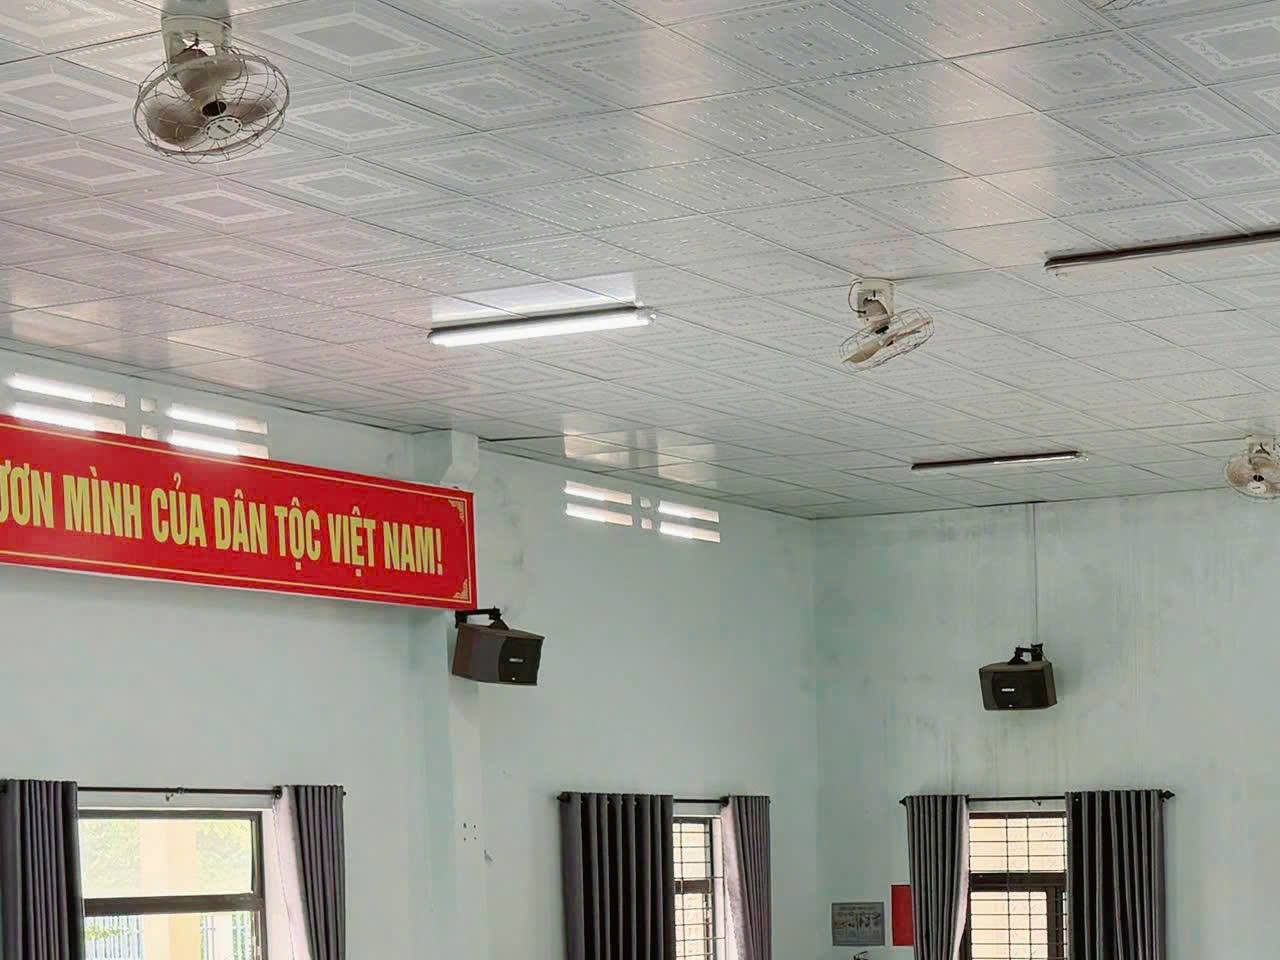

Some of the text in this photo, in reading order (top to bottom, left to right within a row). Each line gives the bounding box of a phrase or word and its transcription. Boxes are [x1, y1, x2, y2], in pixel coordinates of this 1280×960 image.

[62, 465, 143, 539] MÌNH
[150, 472, 207, 548] CỦA
[213, 488, 268, 555] DÂN
[274, 496, 321, 571] TỘC
[327, 506, 376, 577] VIỆT
[383, 521, 443, 576] NAM!
